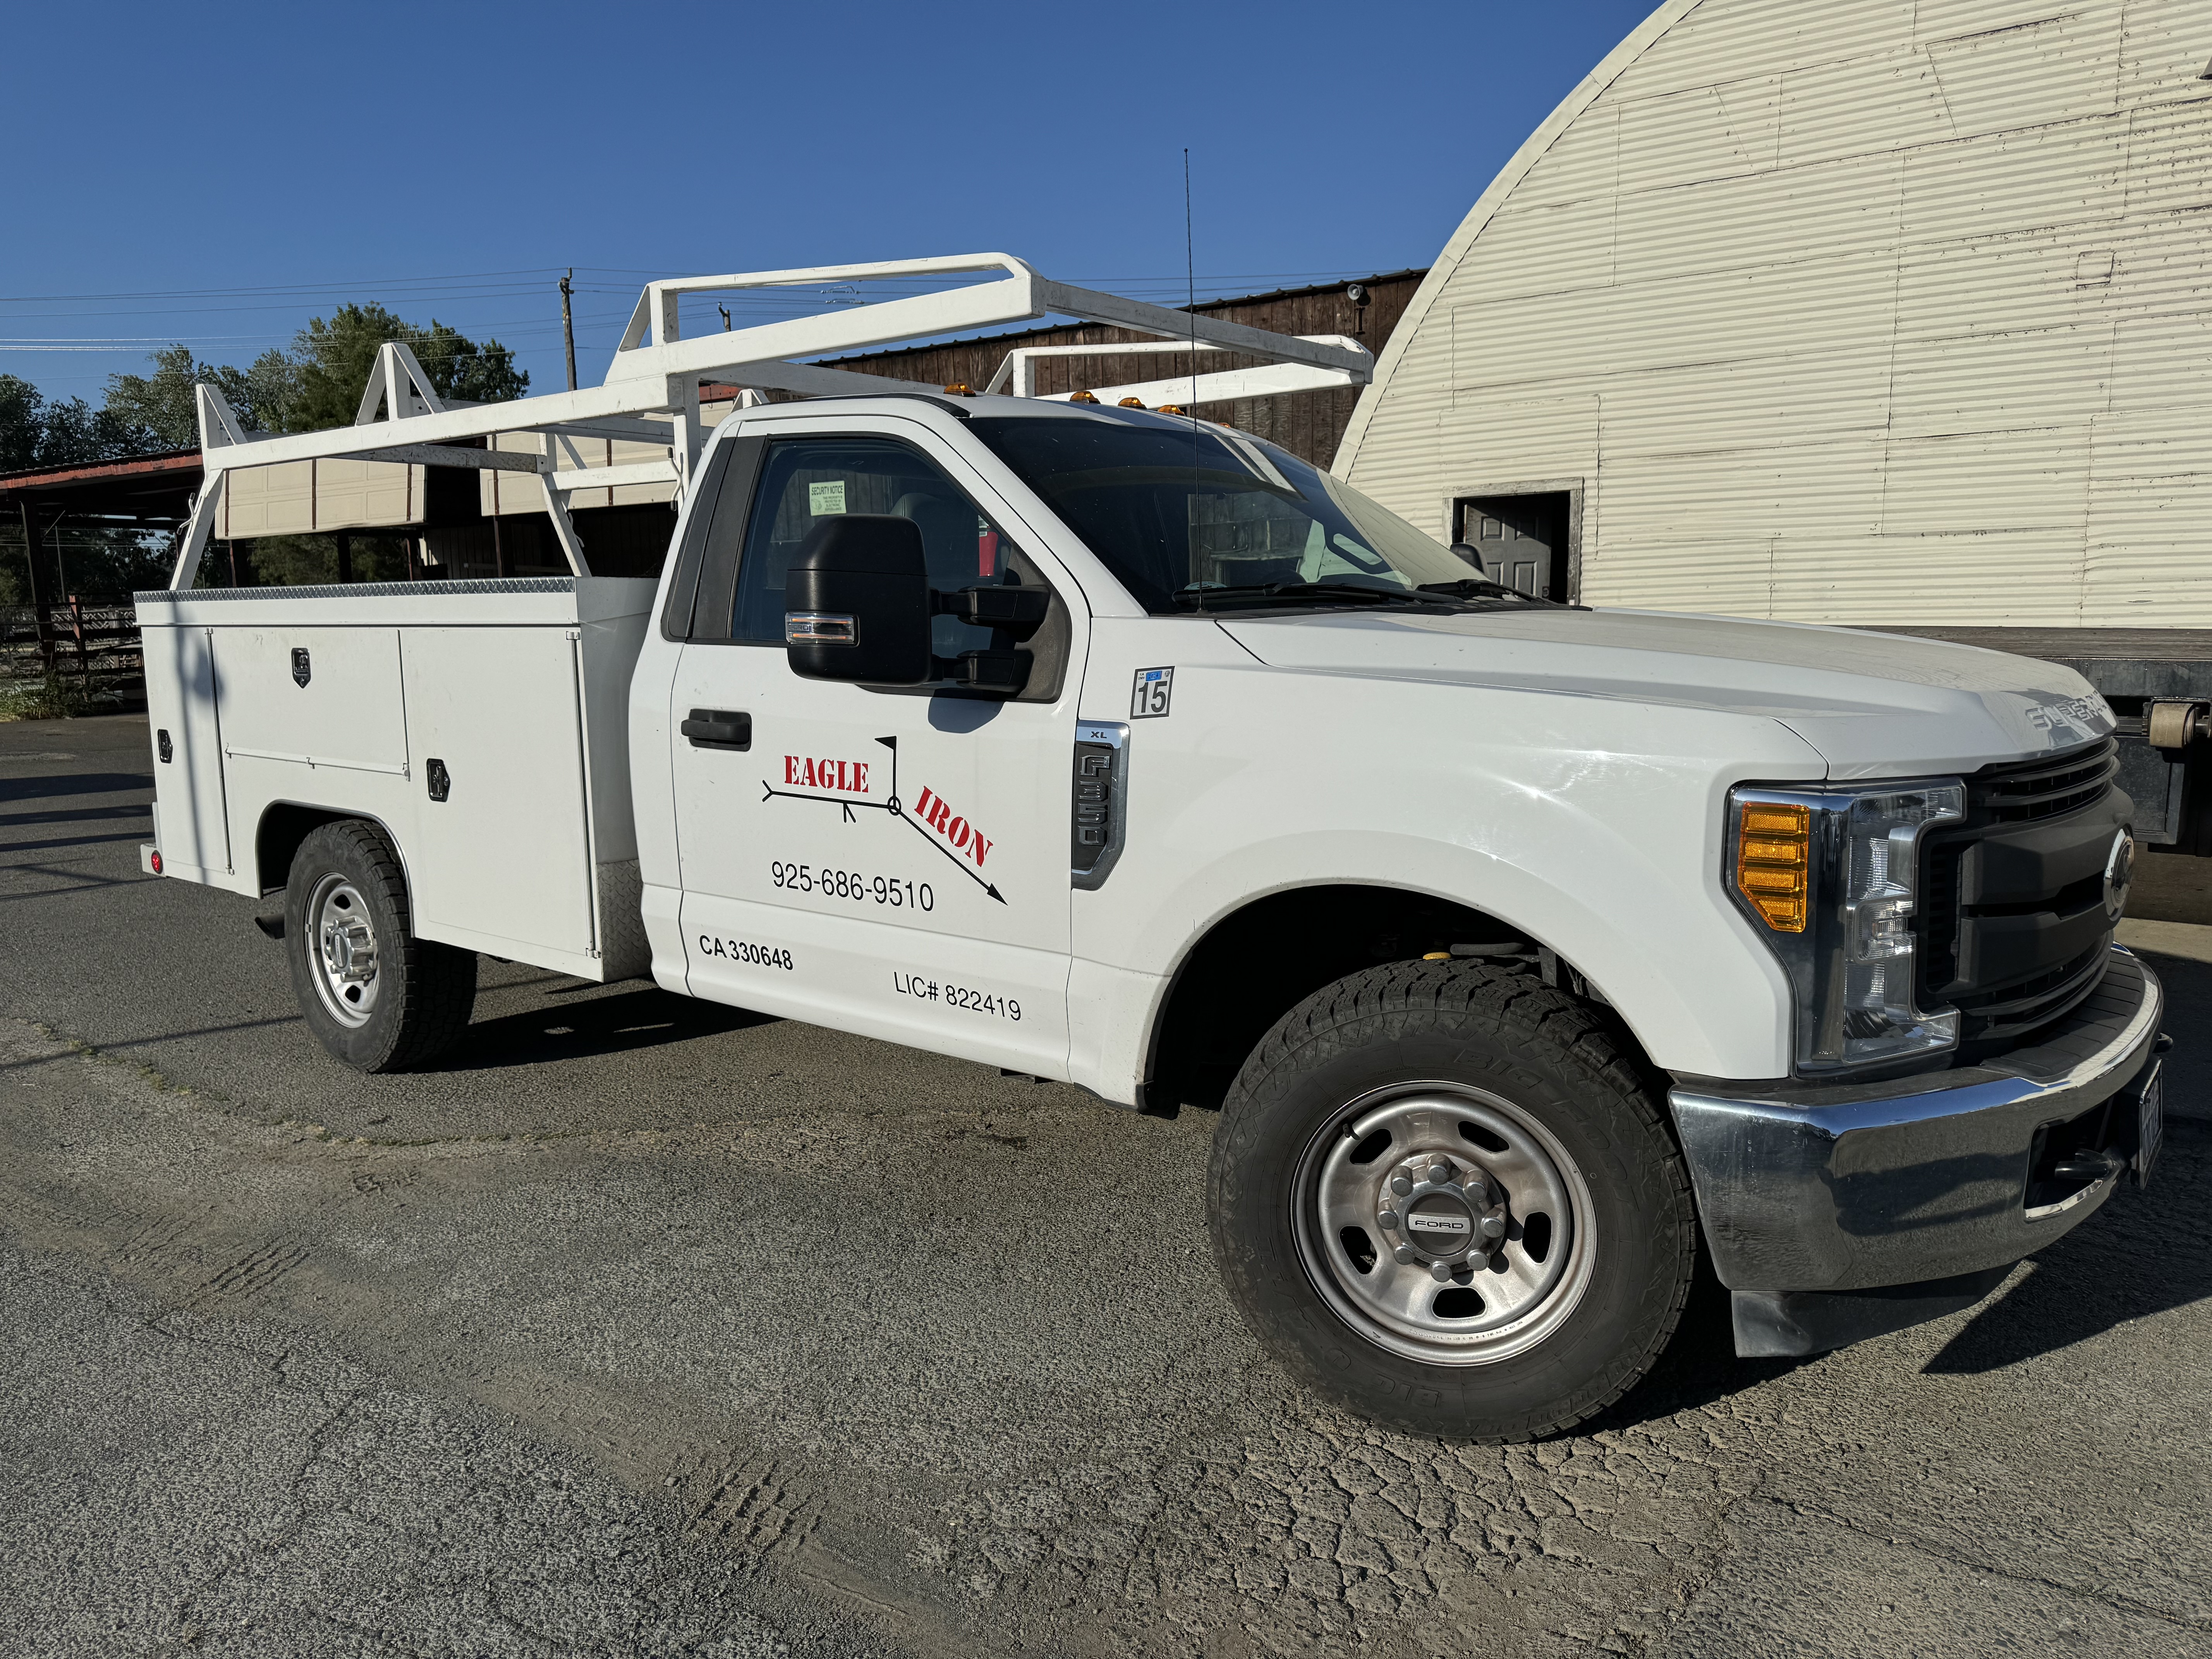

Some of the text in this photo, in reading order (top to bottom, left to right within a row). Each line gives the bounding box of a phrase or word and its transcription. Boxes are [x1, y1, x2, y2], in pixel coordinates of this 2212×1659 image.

[812, 485, 843, 495] SECURITY NOTICE
[1138, 680, 1167, 713] 15
[785, 755, 869, 793] EAGLE
[1078, 755, 1111, 847] F350
[914, 786, 994, 867] IRON
[771, 860, 934, 912] 925-686-9510
[699, 934, 793, 971] CA 330648
[893, 971, 1021, 1021] LIC# 822419
[1454, 1048, 1544, 1089] BIG
[1415, 1220, 1464, 1229] FORD
